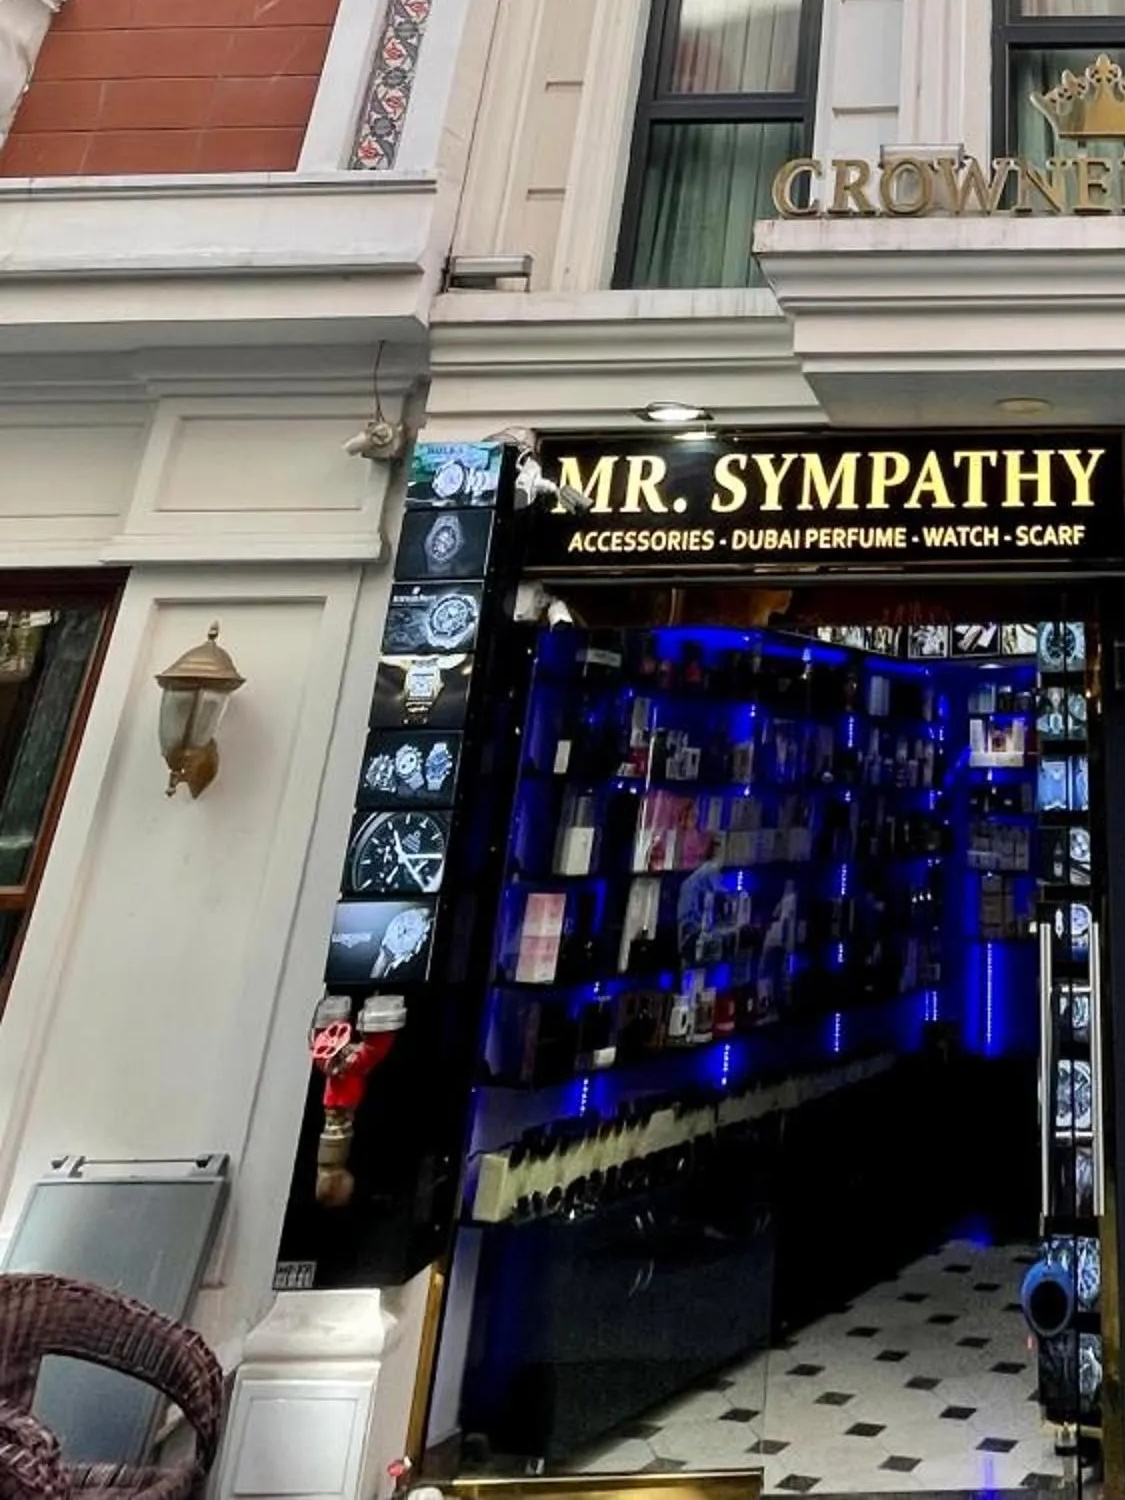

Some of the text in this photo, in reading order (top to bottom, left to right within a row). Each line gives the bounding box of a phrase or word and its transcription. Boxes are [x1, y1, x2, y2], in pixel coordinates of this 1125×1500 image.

[550, 449, 1105, 514] MR. SYMPATHY
[568, 530, 715, 552] ACCESSORIES
[732, 529, 800, 550] DUBAI
[805, 527, 907, 549] PERFUME
[922, 526, 999, 548] WATCH
[1015, 525, 1086, 547] SCARF
